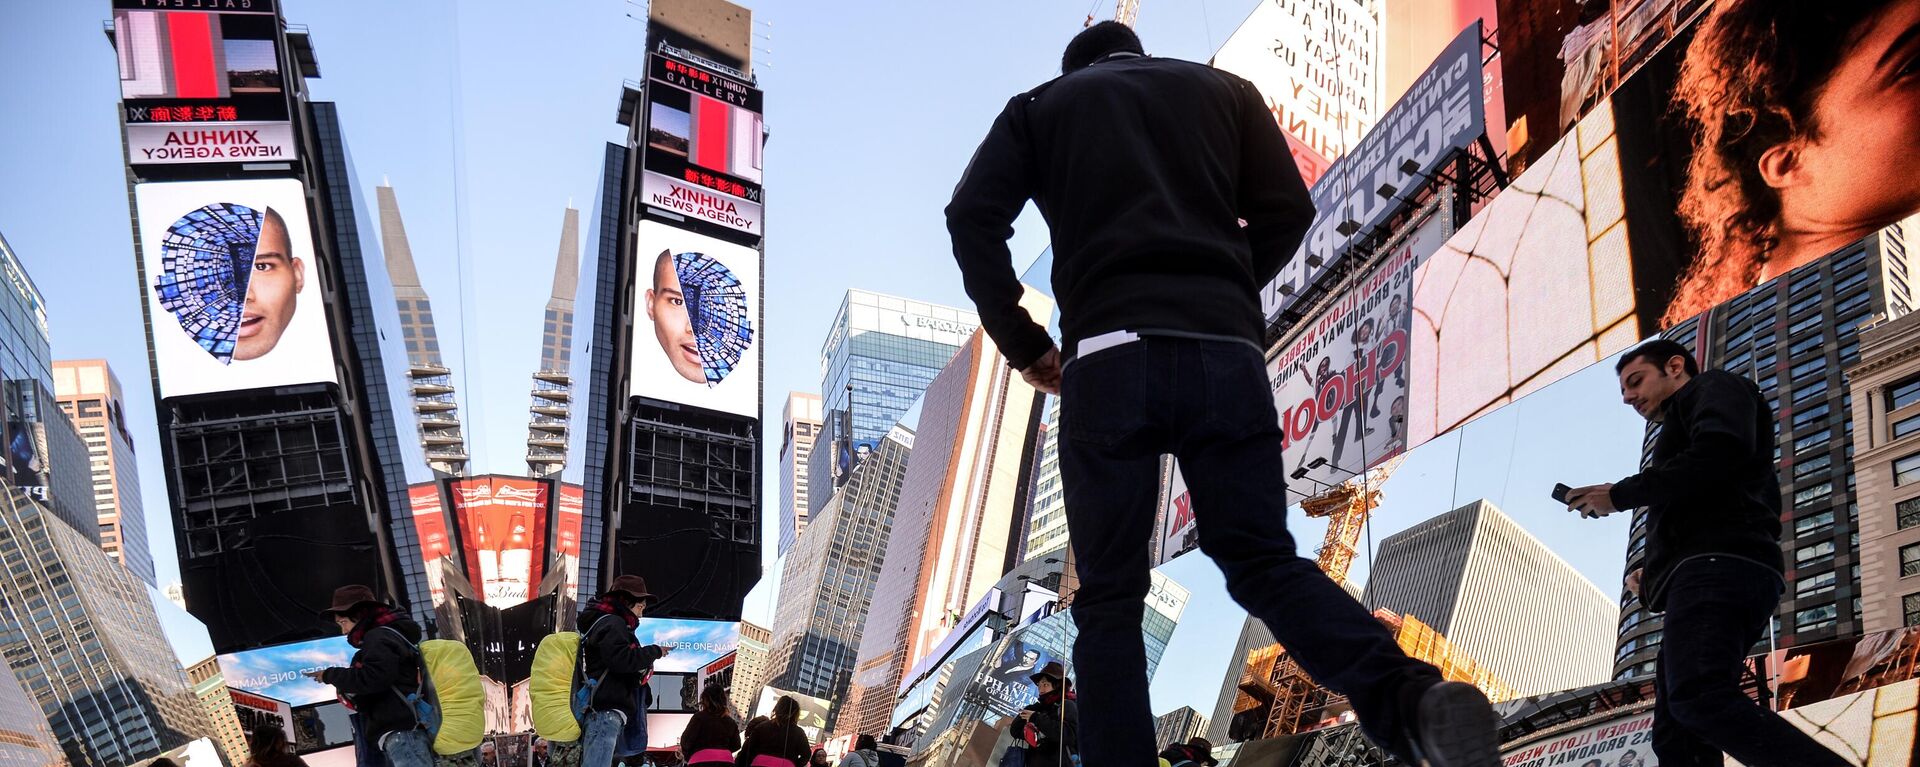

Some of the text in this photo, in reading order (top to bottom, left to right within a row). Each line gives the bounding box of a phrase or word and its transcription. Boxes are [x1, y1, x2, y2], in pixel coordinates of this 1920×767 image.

[666, 72, 746, 106] GALLERY
[712, 76, 748, 96] XINHUA
[652, 193, 752, 230] NEWS AGENCY
[669, 184, 739, 216] XINHUA
[693, 642, 712, 651] ONE
[1012, 681, 1031, 692] THE
